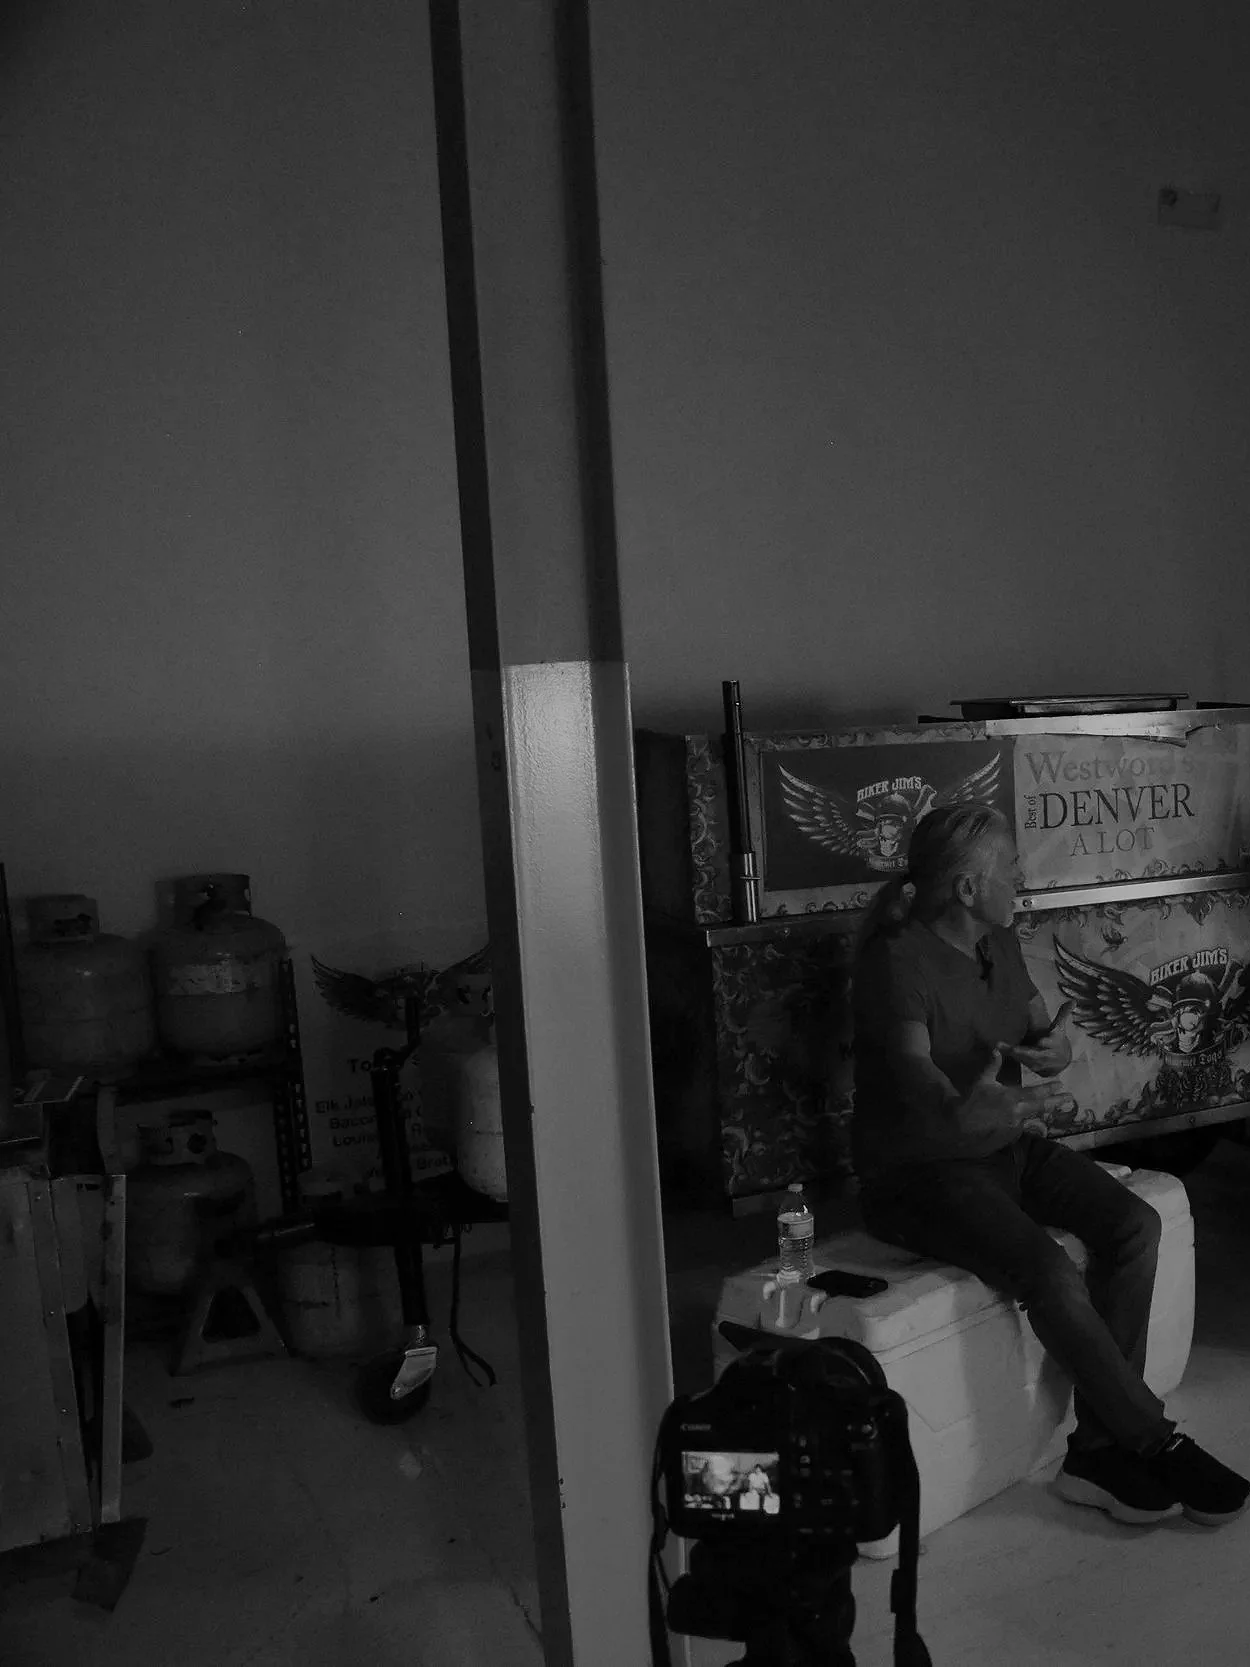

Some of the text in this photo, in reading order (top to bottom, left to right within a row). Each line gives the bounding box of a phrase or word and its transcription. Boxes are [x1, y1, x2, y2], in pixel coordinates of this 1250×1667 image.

[856, 780, 889, 802] BIKER
[1039, 783, 1195, 830] DENVER
[1024, 794, 1037, 830] Best of
[1150, 955, 1189, 986] BIKER
